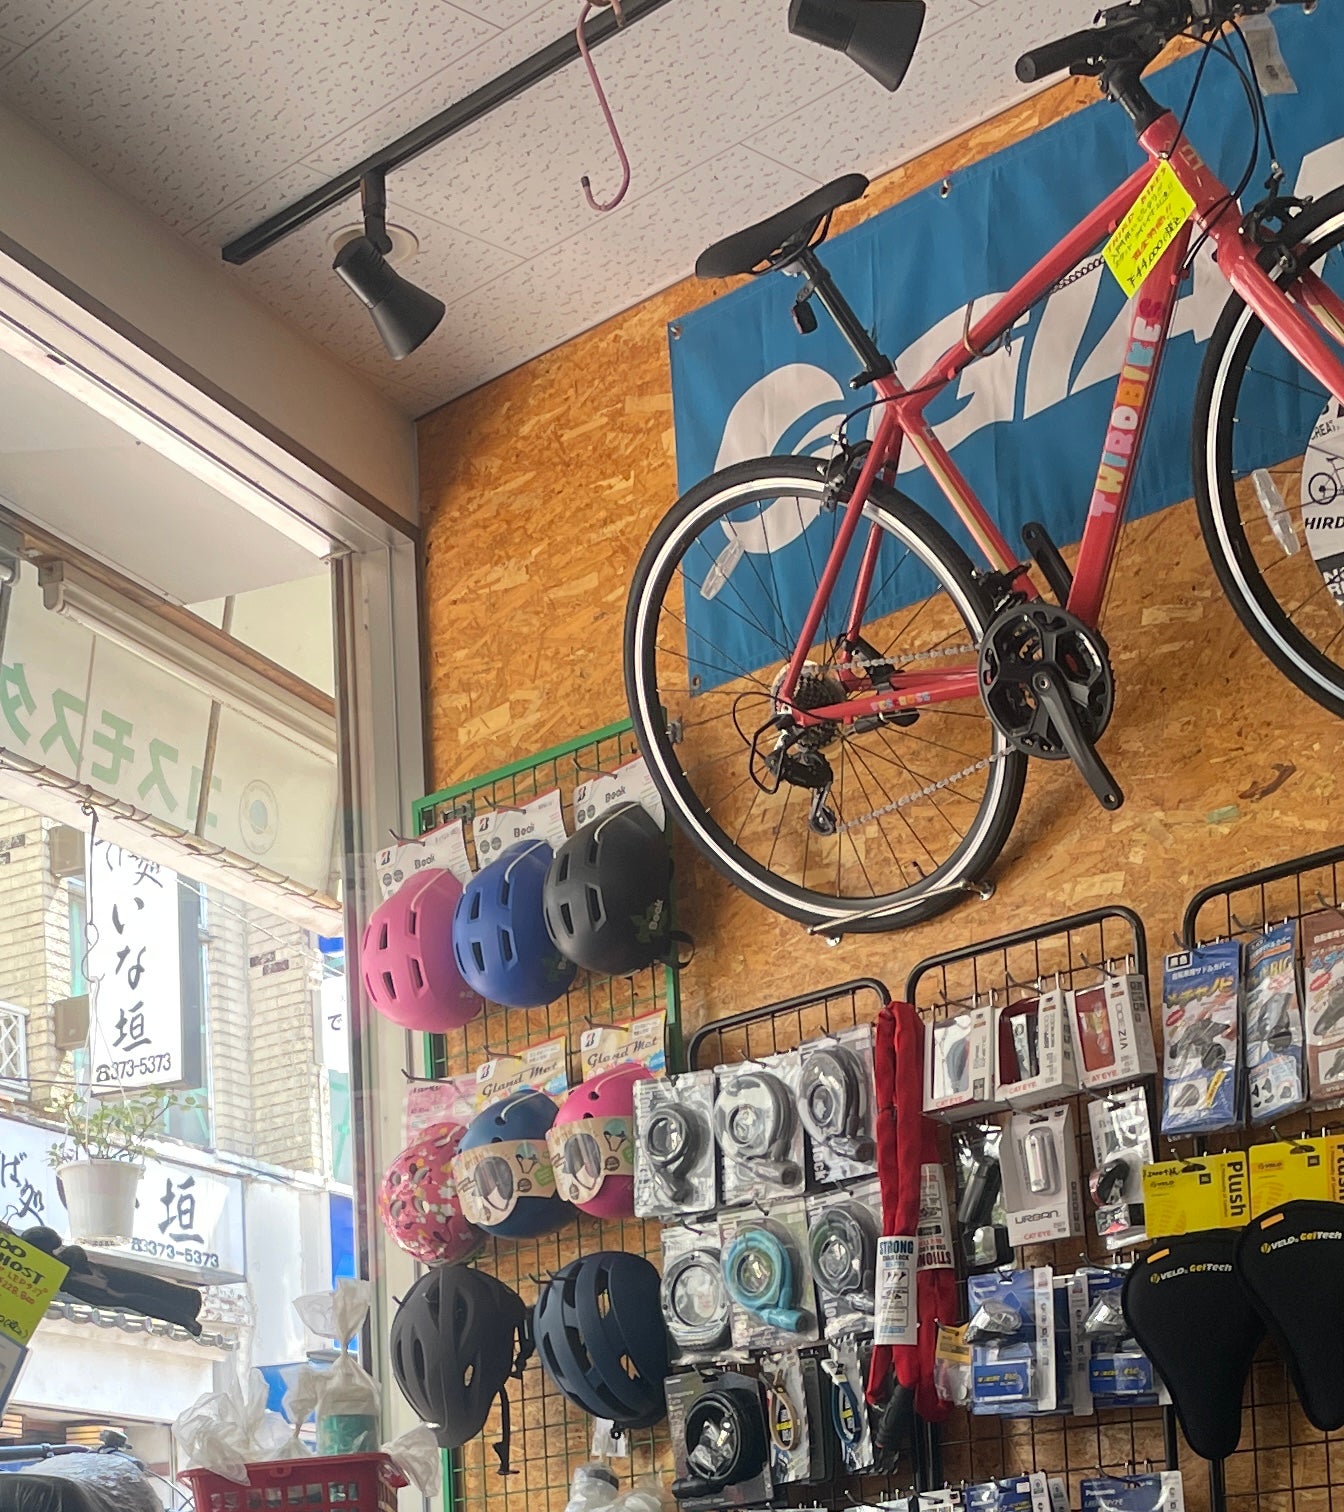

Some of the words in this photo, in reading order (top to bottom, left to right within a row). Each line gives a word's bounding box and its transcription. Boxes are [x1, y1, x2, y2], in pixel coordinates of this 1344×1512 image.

[1089, 297, 1166, 518] THIRDBIKES
[1227, 1160, 1244, 1217] Plush
[880, 1240, 914, 1256] STRONG
[1271, 1236, 1295, 1251] VELO
[1160, 1267, 1186, 1281] VELO
[1189, 1262, 1233, 1273] GelTech
